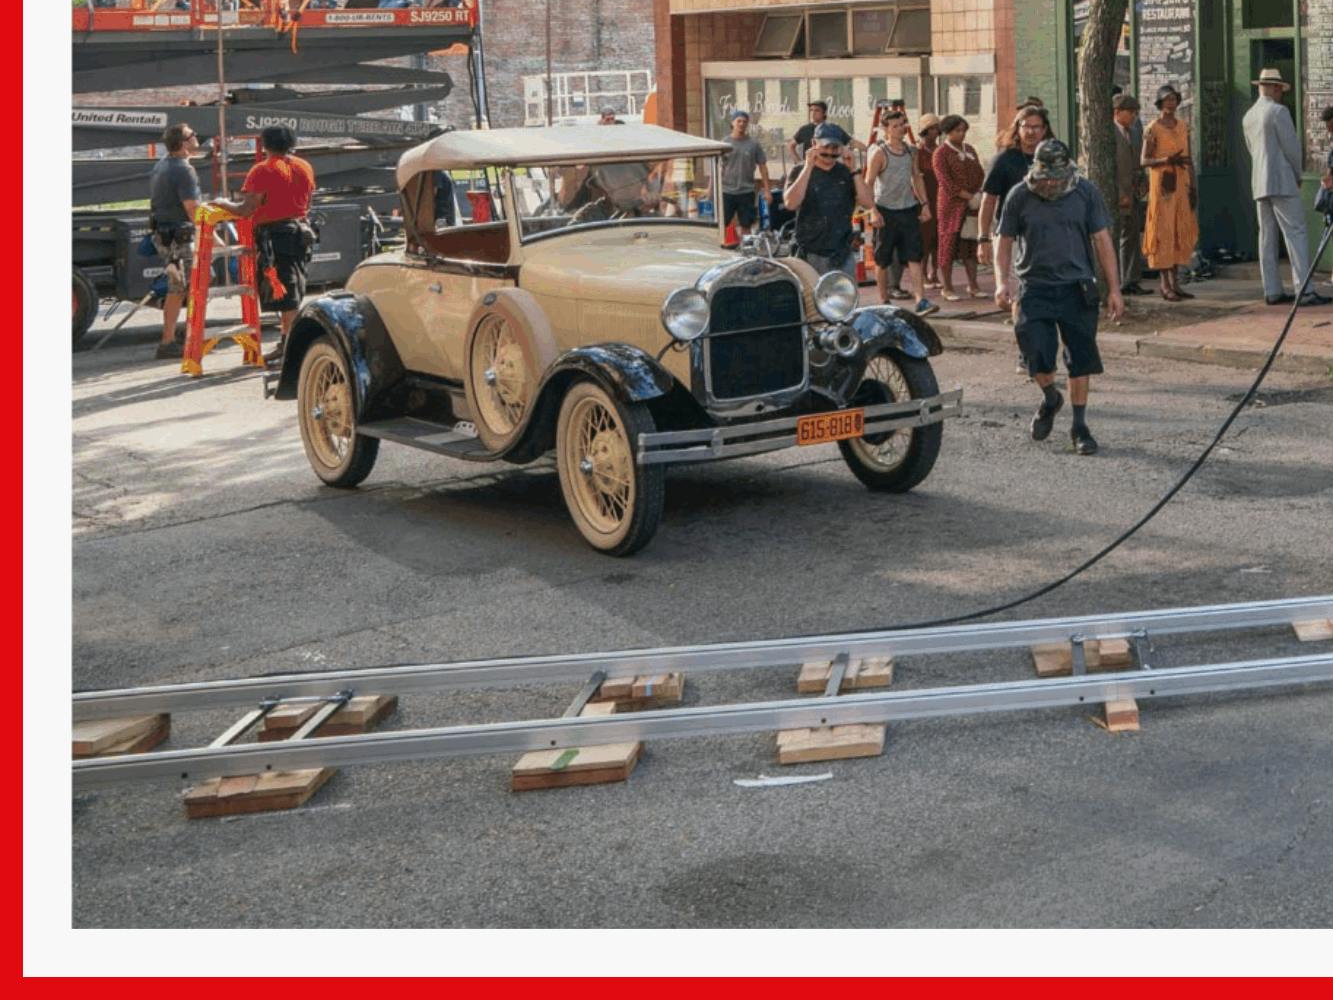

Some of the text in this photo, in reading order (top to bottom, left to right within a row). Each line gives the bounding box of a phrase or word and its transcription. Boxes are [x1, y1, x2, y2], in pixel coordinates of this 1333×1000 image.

[410, 11, 452, 23] SJ9250
[455, 10, 469, 21] RT
[71, 111, 162, 125] United Rentals
[800, 415, 852, 440] 615-818
